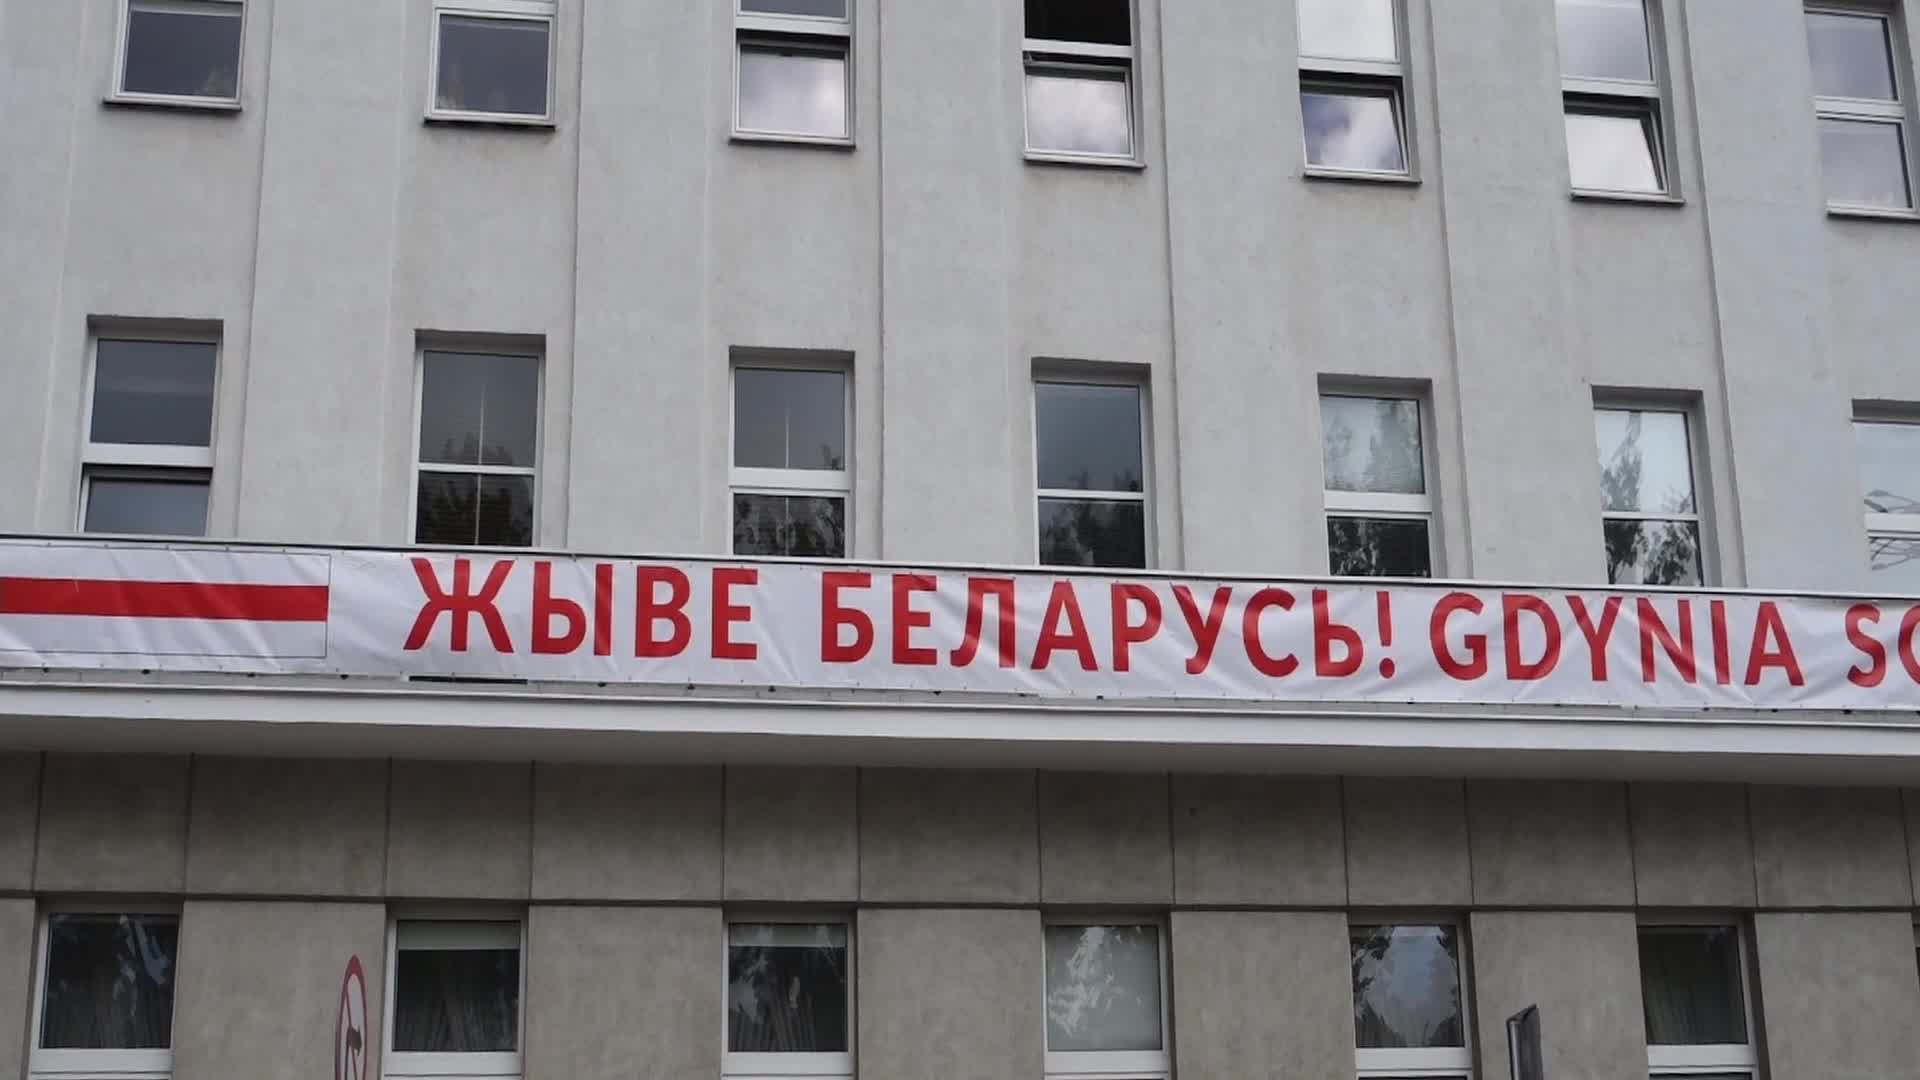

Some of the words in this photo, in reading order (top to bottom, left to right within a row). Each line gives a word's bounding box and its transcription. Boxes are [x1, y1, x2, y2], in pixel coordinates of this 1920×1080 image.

[403, 557, 759, 659] ЖЫВЕ
[821, 569, 1396, 679] БЕЛАРУСЬ!
[1430, 592, 1805, 688] GDYNIA
